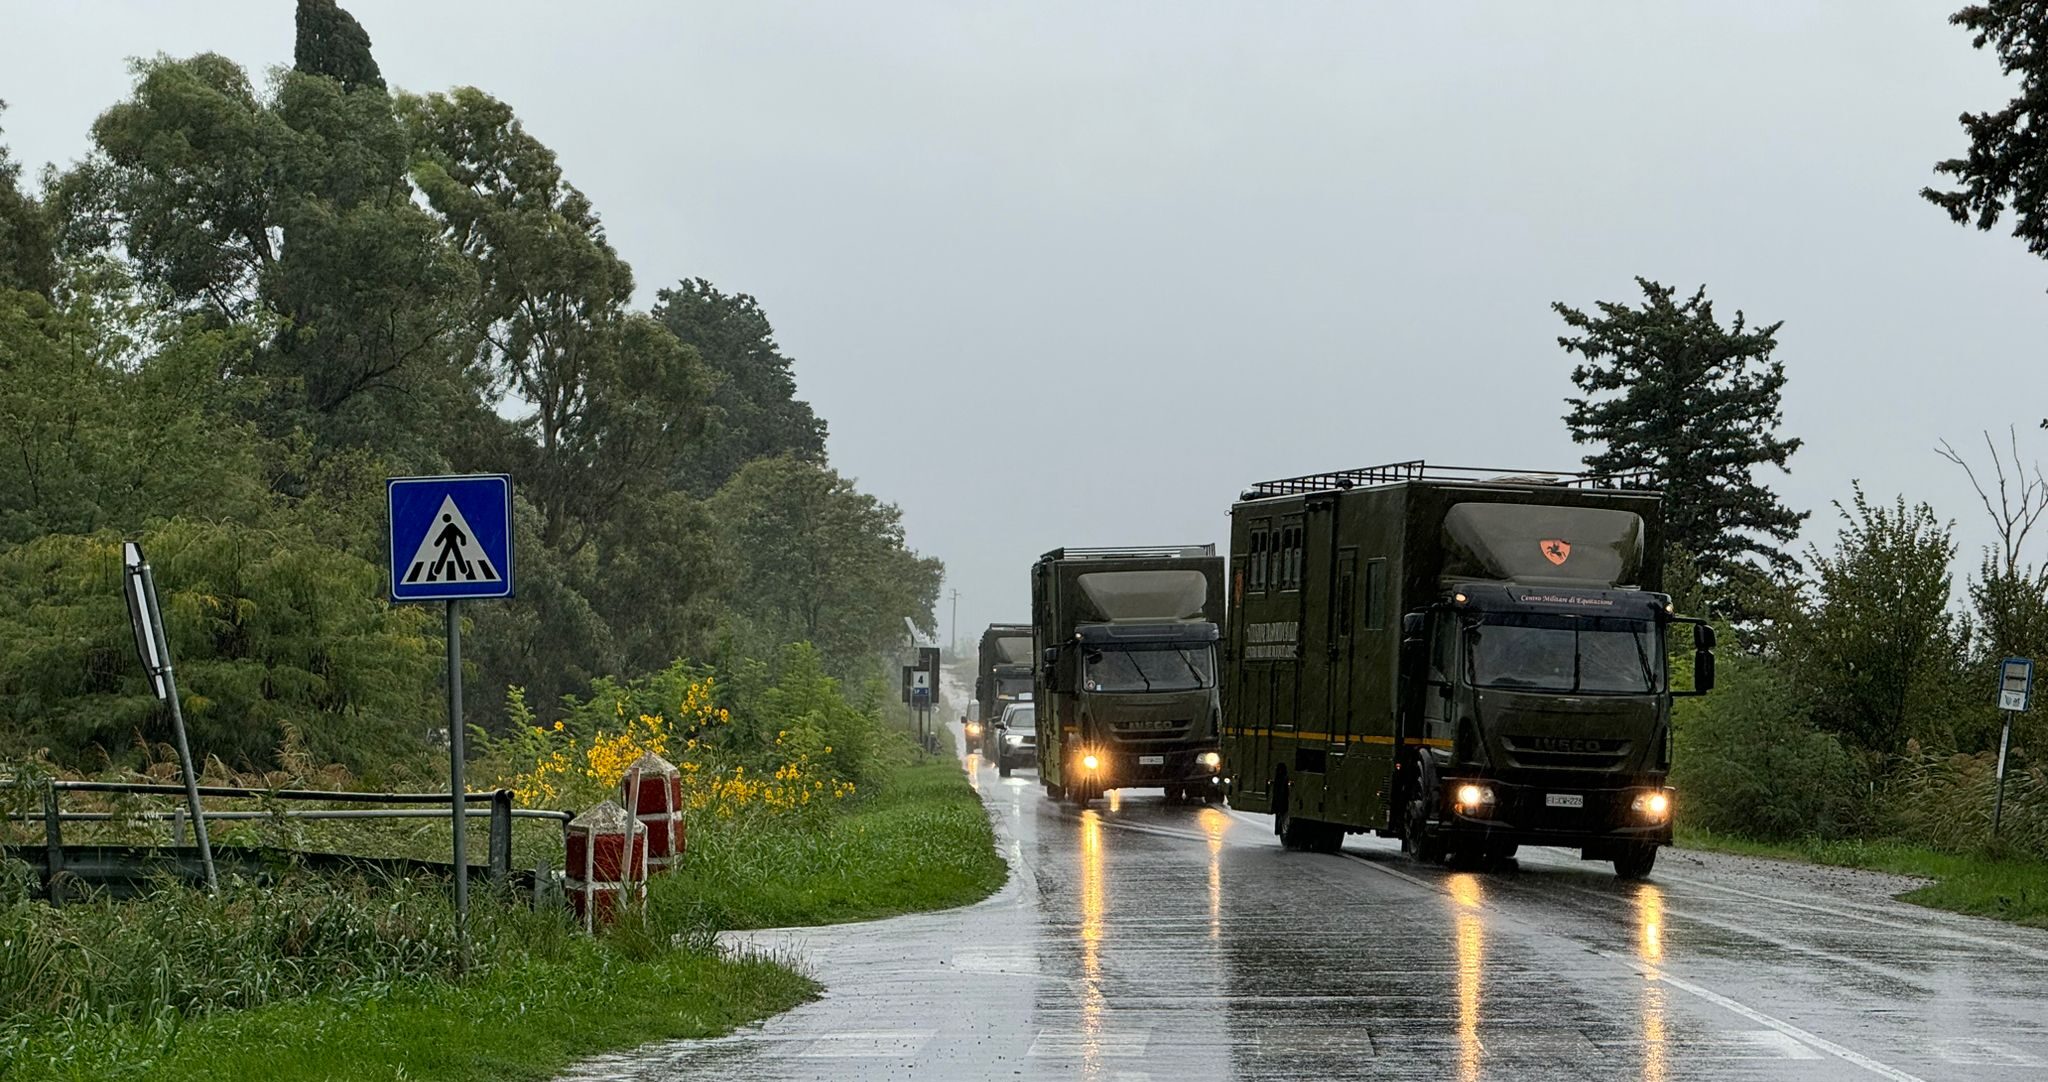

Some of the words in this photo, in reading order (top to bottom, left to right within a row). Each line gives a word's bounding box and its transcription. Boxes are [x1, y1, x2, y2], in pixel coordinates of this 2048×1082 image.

[1520, 594, 1542, 602] Centro
[1542, 595, 1568, 603] Militare
[1576, 597, 1613, 606] Equitazione
[918, 675, 923, 684] 4
[1129, 720, 1172, 729] IVECO
[1535, 738, 1600, 752] IVECO
